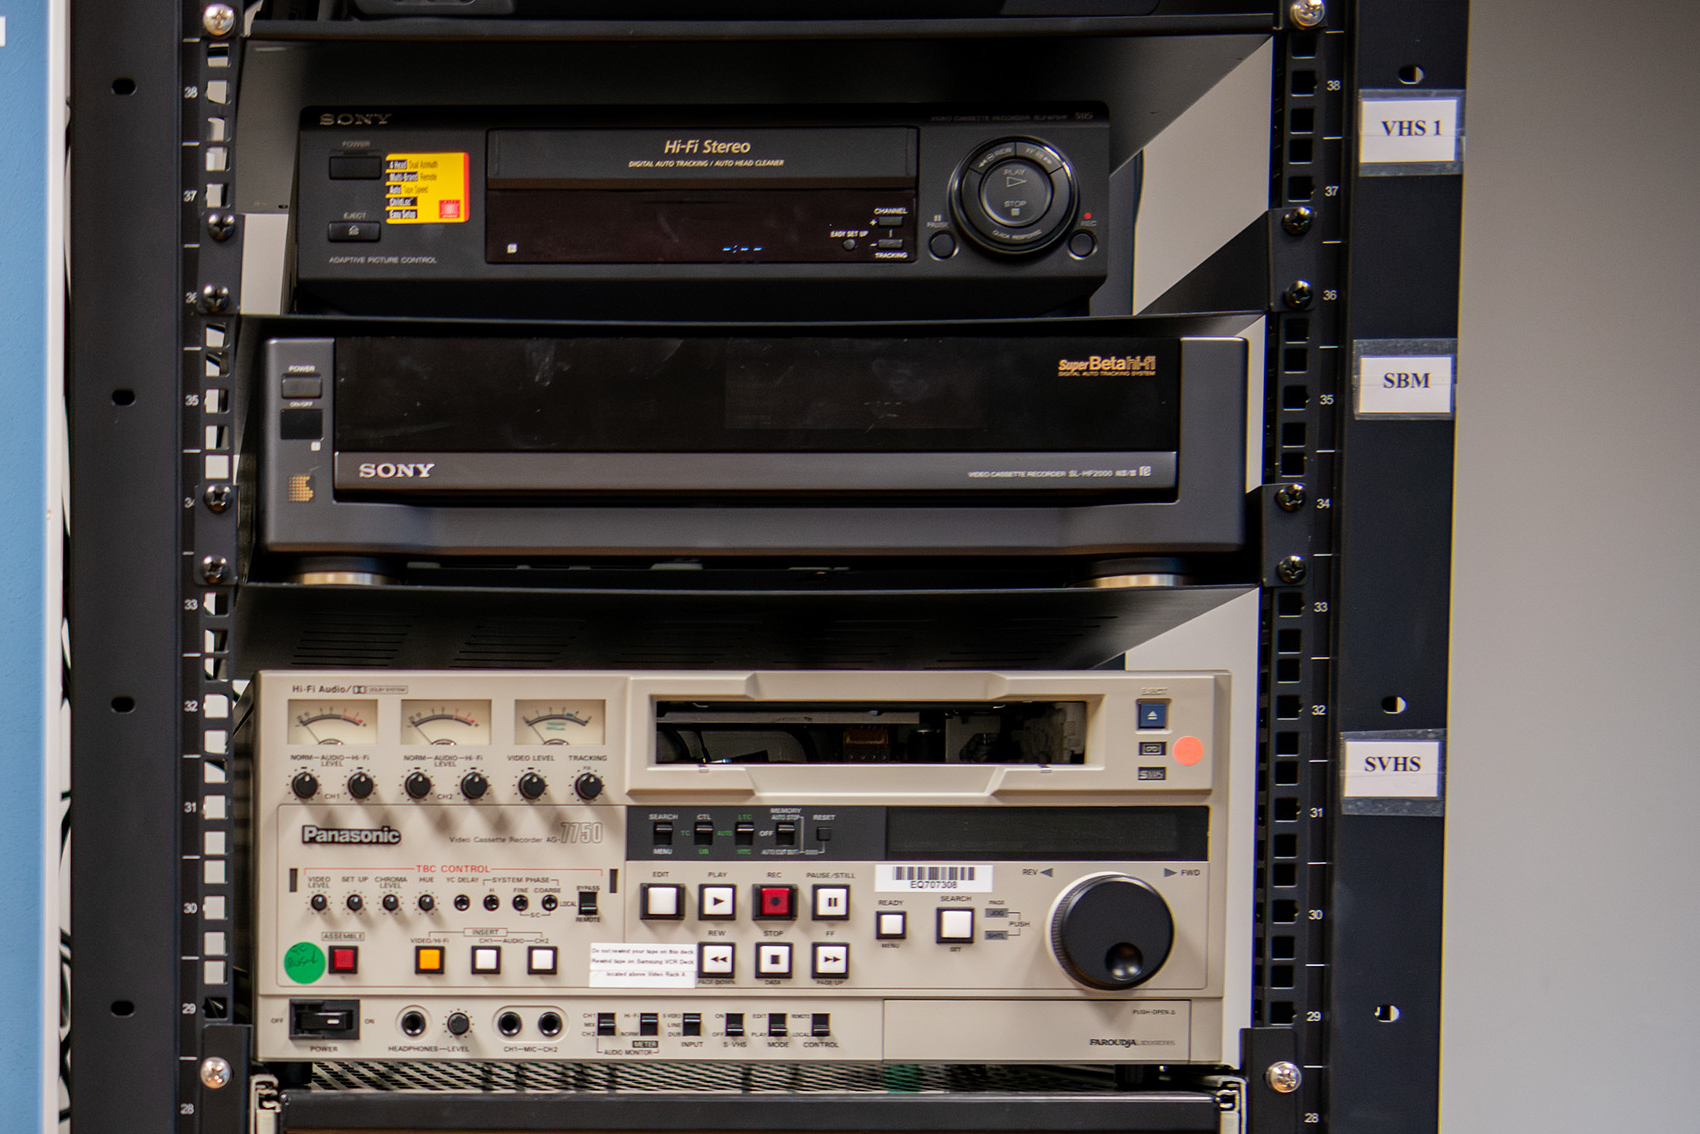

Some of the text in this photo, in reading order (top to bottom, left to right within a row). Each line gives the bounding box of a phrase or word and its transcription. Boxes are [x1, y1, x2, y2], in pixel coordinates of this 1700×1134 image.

[1327, 80, 1340, 90] 38
[320, 114, 392, 125] SONY
[1382, 120, 1441, 136] VHS 1
[665, 139, 750, 153] Hi-Fi Stereo
[1325, 186, 1339, 196] 37
[1383, 373, 1431, 388] SBM
[1320, 395, 1334, 405] 35
[360, 464, 434, 478] SONY
[1312, 705, 1325, 715] 32
[1365, 756, 1421, 771] SVHS
[304, 826, 400, 843] Panasonic
[560, 822, 602, 843] 7750
[416, 865, 490, 873] TBC CONTROL
[910, 881, 957, 889] EQ707308
